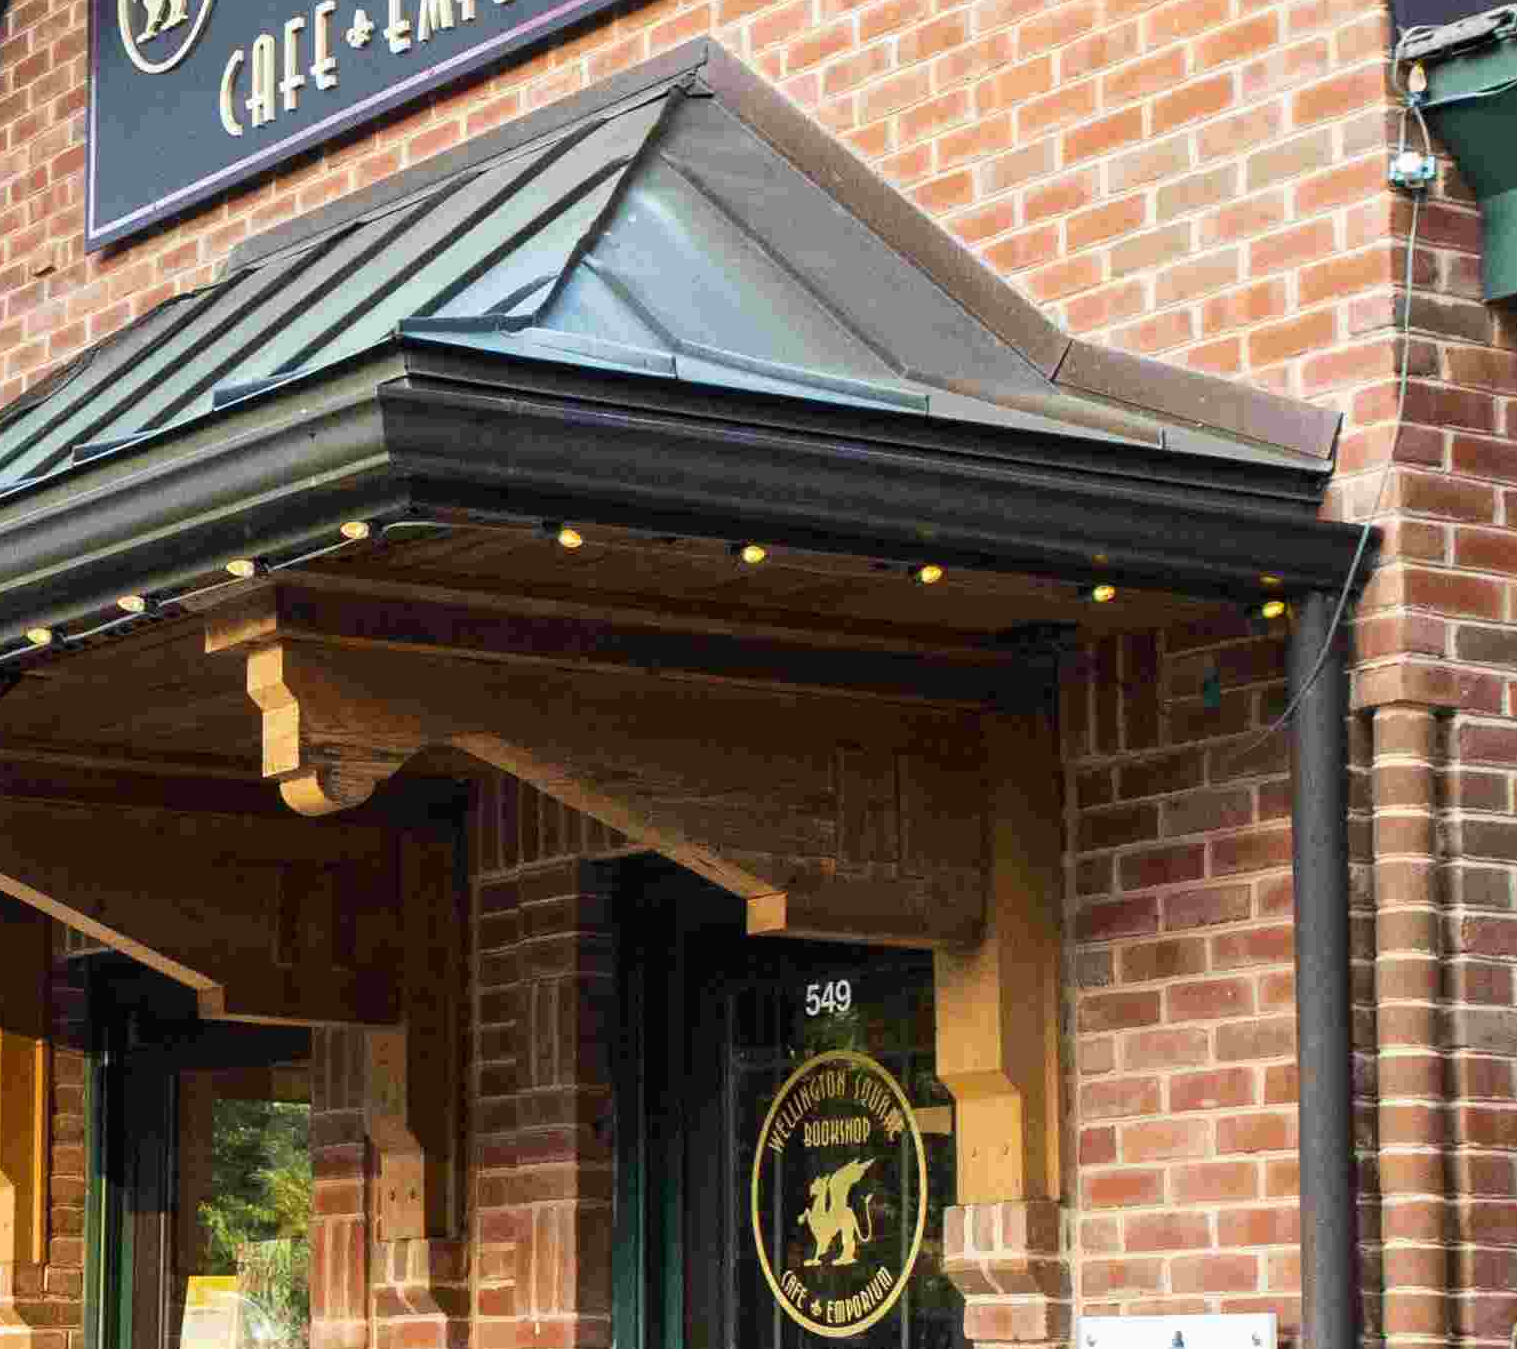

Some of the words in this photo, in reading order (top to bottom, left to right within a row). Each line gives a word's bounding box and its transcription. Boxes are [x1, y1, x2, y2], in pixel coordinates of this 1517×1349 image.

[805, 979, 852, 1016] 549
[768, 1069, 847, 1153] WELLINGTON
[803, 1117, 871, 1147] BOOKSHOP
[827, 1266, 894, 1324] EMPORIUM
